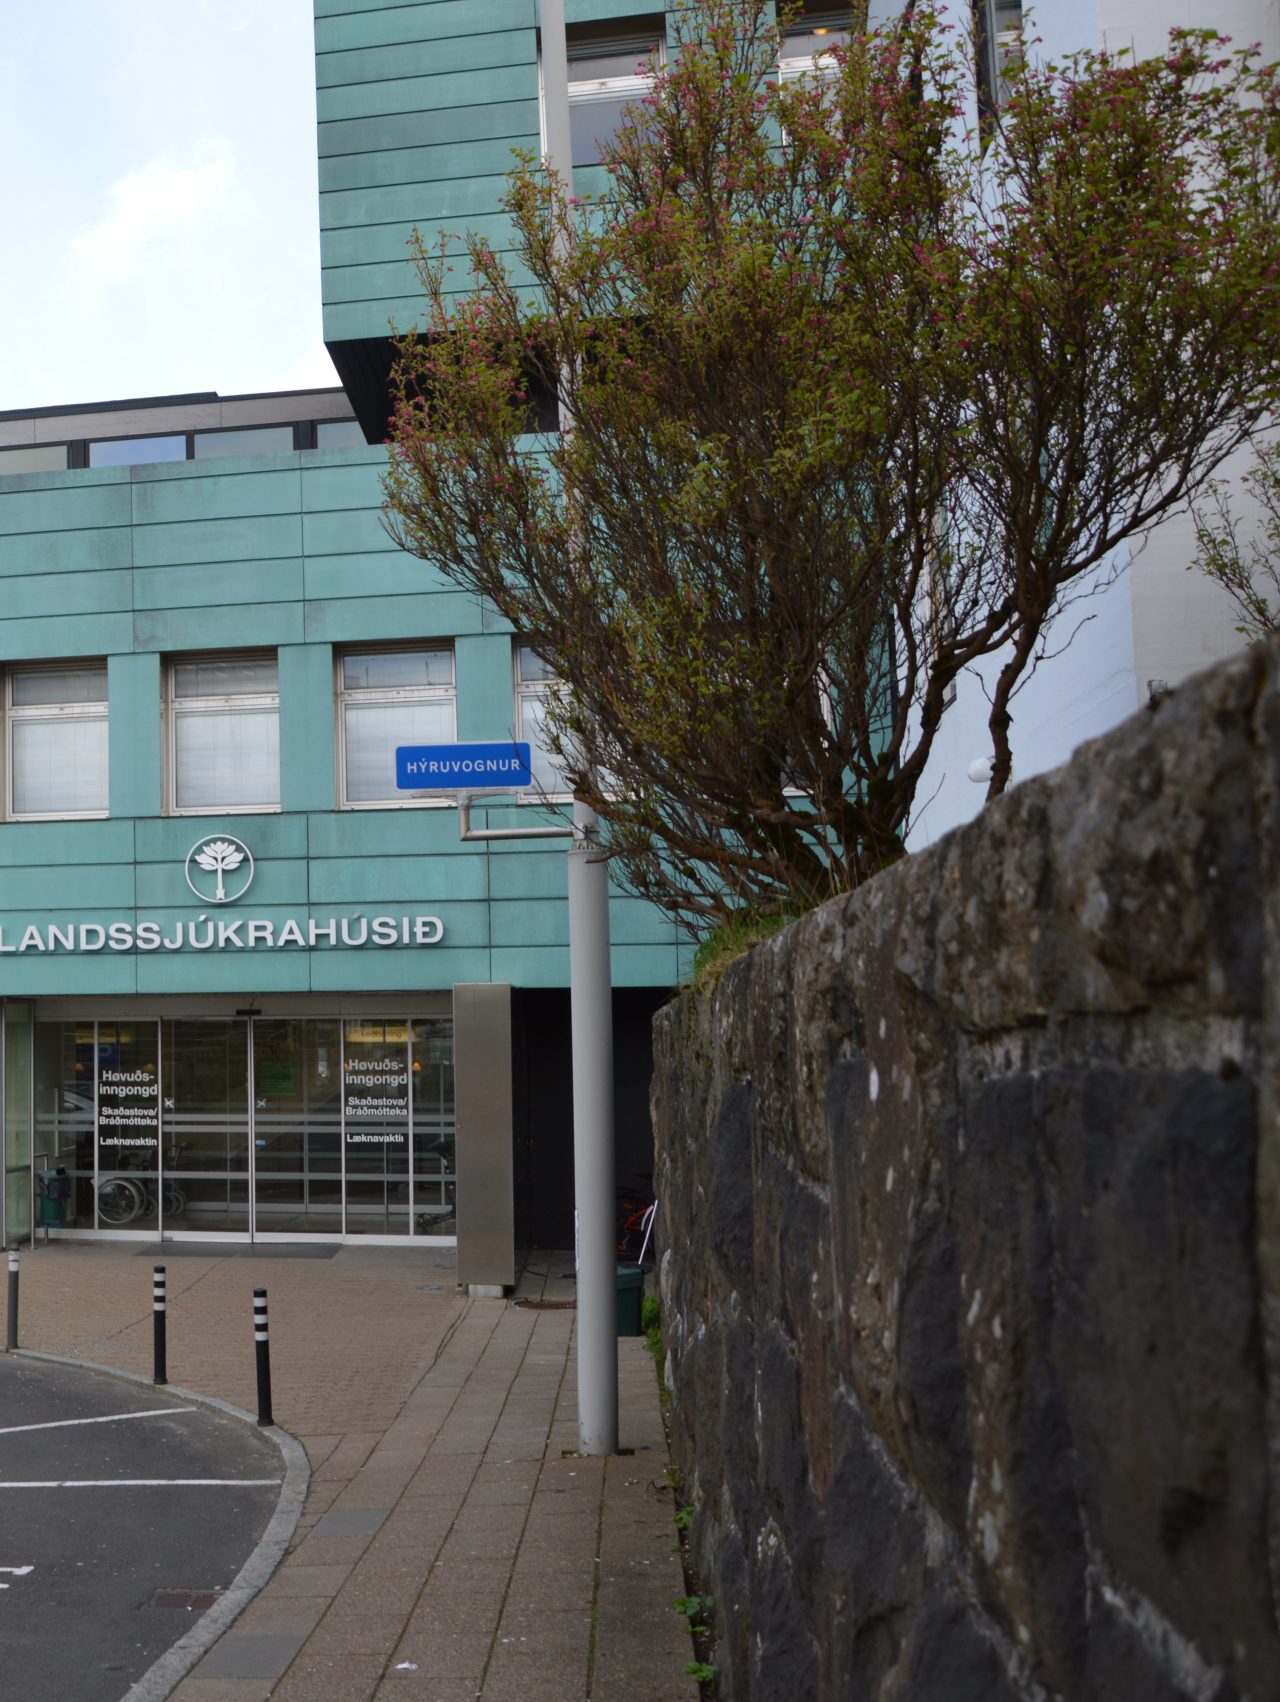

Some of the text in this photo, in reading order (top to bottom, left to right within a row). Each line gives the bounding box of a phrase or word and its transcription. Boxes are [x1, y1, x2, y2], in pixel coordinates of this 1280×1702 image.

[407, 758, 520, 774] HÝRUVOGNUR
[349, 1058, 404, 1070] Høvuðs-
[102, 1070, 154, 1082] Høvuðs-
[345, 1073, 408, 1087] inngongd
[99, 1084, 158, 1097] inngongd
[100, 1137, 157, 1146] Læknavaktin
